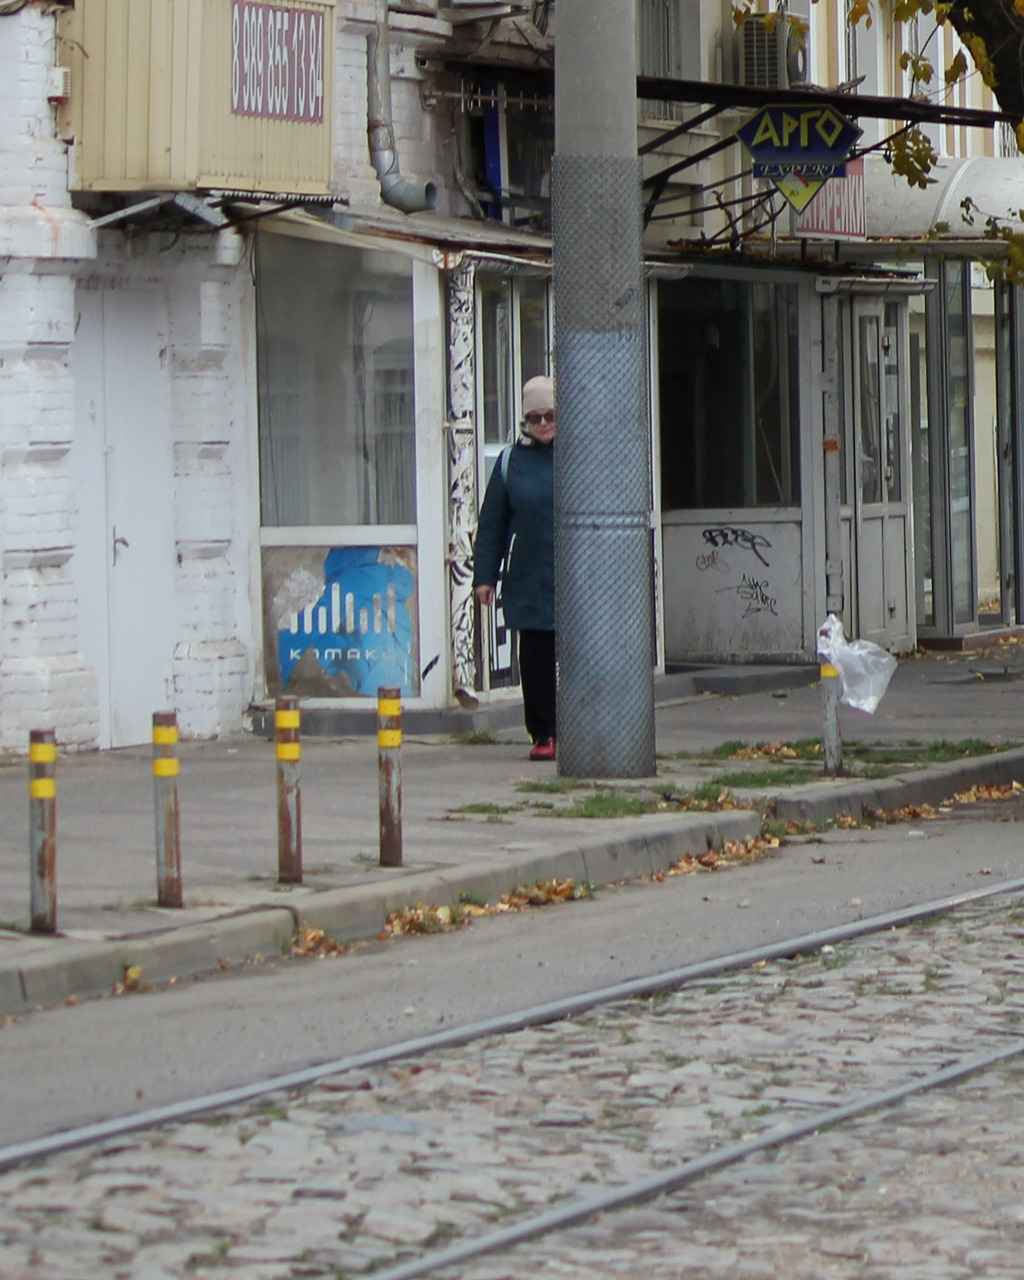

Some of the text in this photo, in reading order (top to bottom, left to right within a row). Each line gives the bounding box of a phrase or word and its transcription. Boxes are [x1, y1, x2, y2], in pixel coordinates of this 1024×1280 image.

[232, 3, 323, 119] 8 989 855 13 84
[751, 108, 844, 148] АРГО
